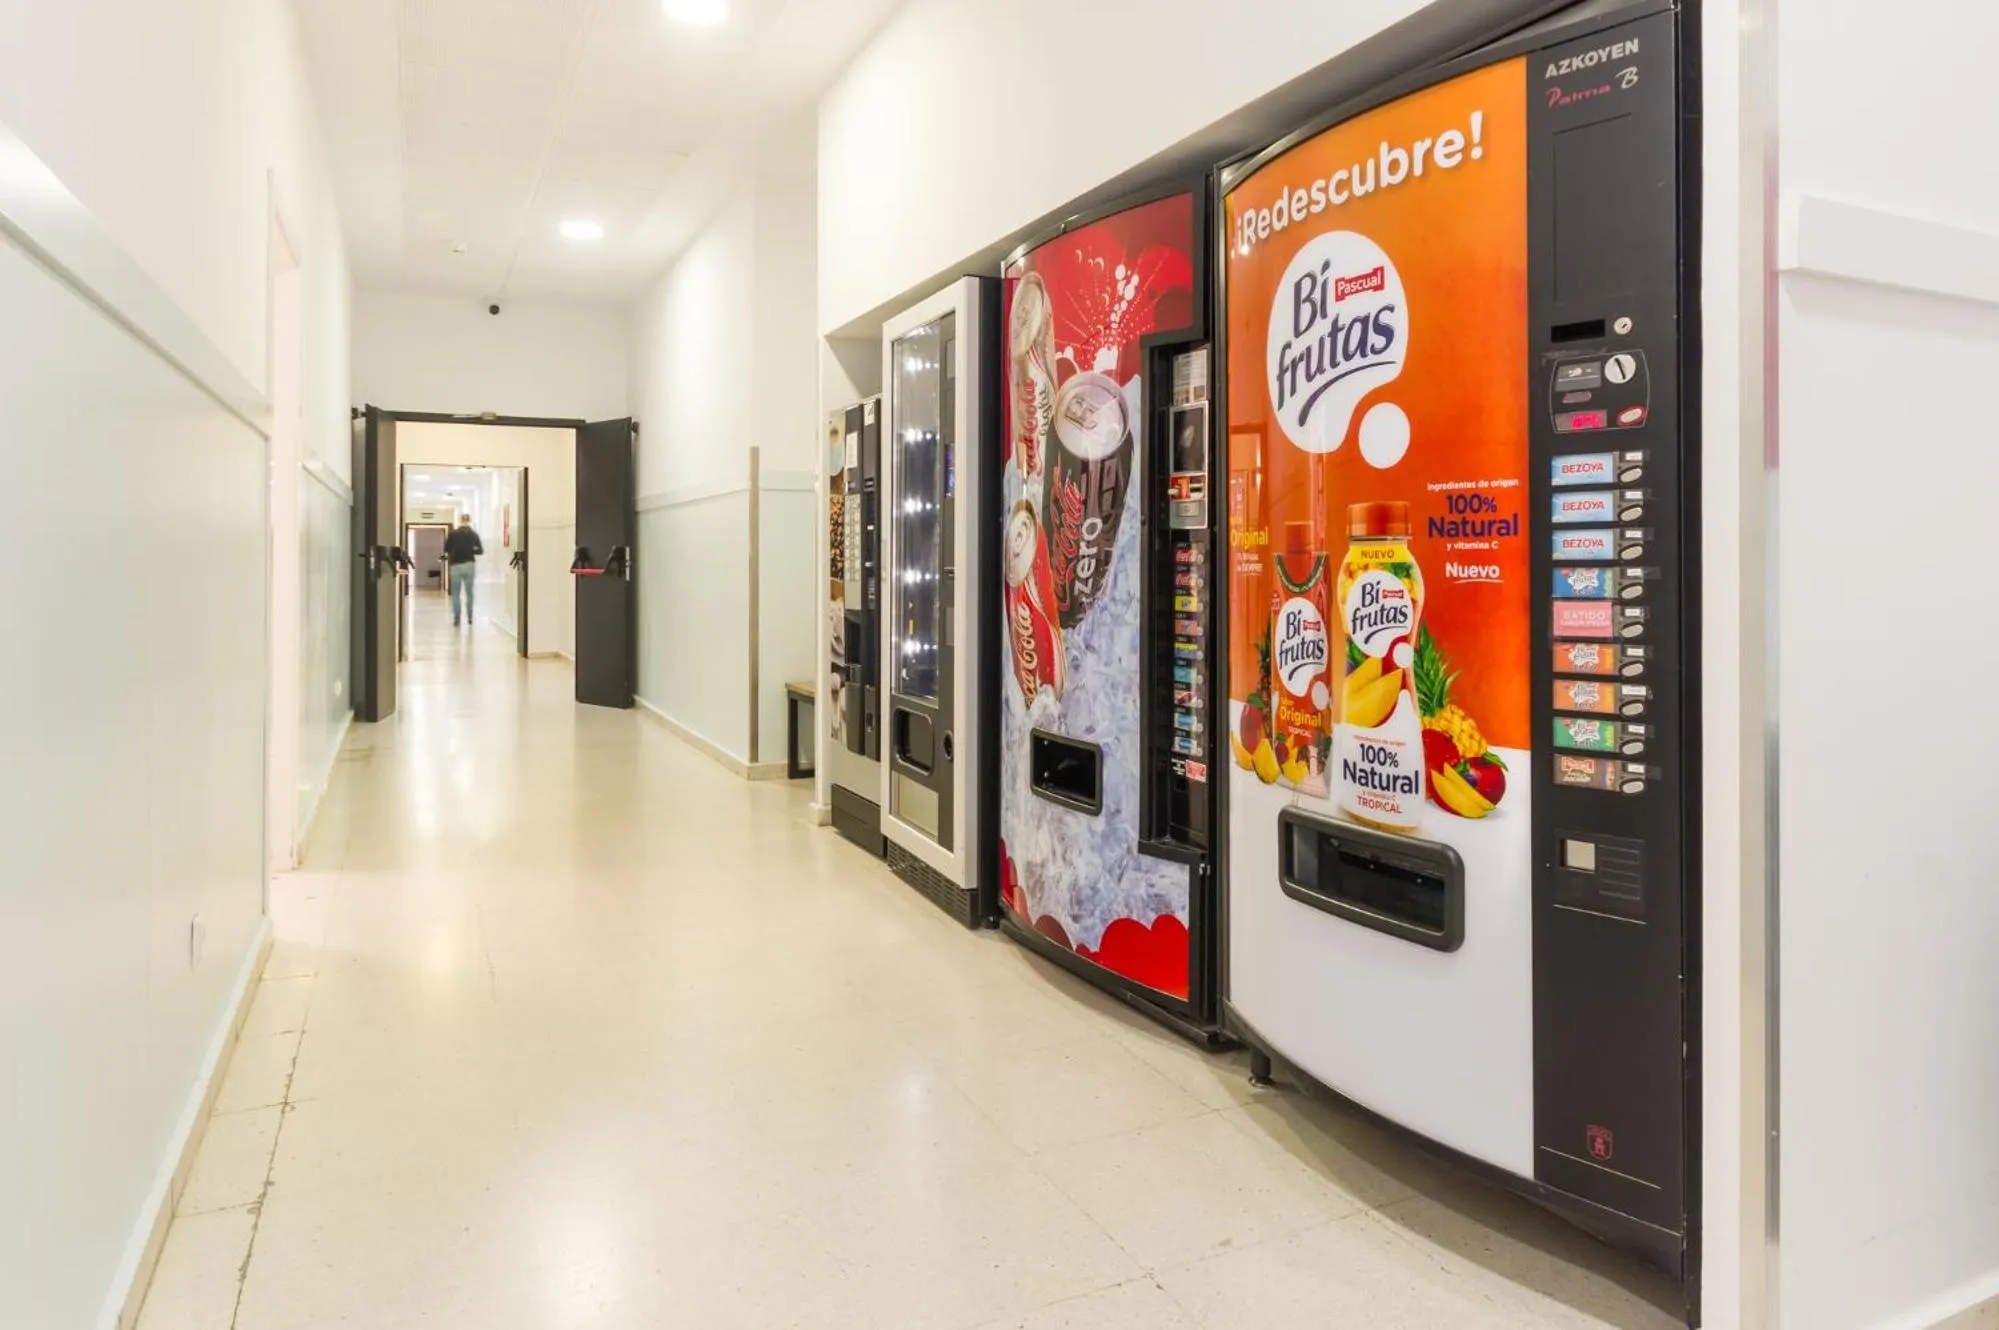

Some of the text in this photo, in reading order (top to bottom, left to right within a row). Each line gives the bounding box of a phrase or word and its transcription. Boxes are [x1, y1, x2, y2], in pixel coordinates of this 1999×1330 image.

[1545, 37, 1639, 79] AZKOYEN
[1614, 66, 1639, 89] B
[1233, 110, 1484, 254] ¡Redescubre!
[1337, 270, 1382, 296] Pascual
[1276, 303, 1396, 411] frutas
[1561, 463, 1604, 473] BEZOYA
[1478, 480, 1489, 489] de
[1446, 493, 1498, 514] 100%
[1562, 501, 1604, 511] BEZOYA
[1428, 513, 1519, 538] Natural
[1361, 549, 1395, 559] NUEVO
[1491, 541, 1499, 549] C
[1562, 539, 1604, 548] BEZOYA
[1074, 517, 1102, 596] zero
[1445, 562, 1500, 578] Nuevo
[1352, 604, 1408, 635] frutas
[1279, 637, 1324, 670] frutas
[1280, 706, 1322, 727] Original
[1359, 743, 1399, 768] 100%
[1343, 759, 1420, 795] Natural
[1357, 796, 1402, 813] TROPICAL
